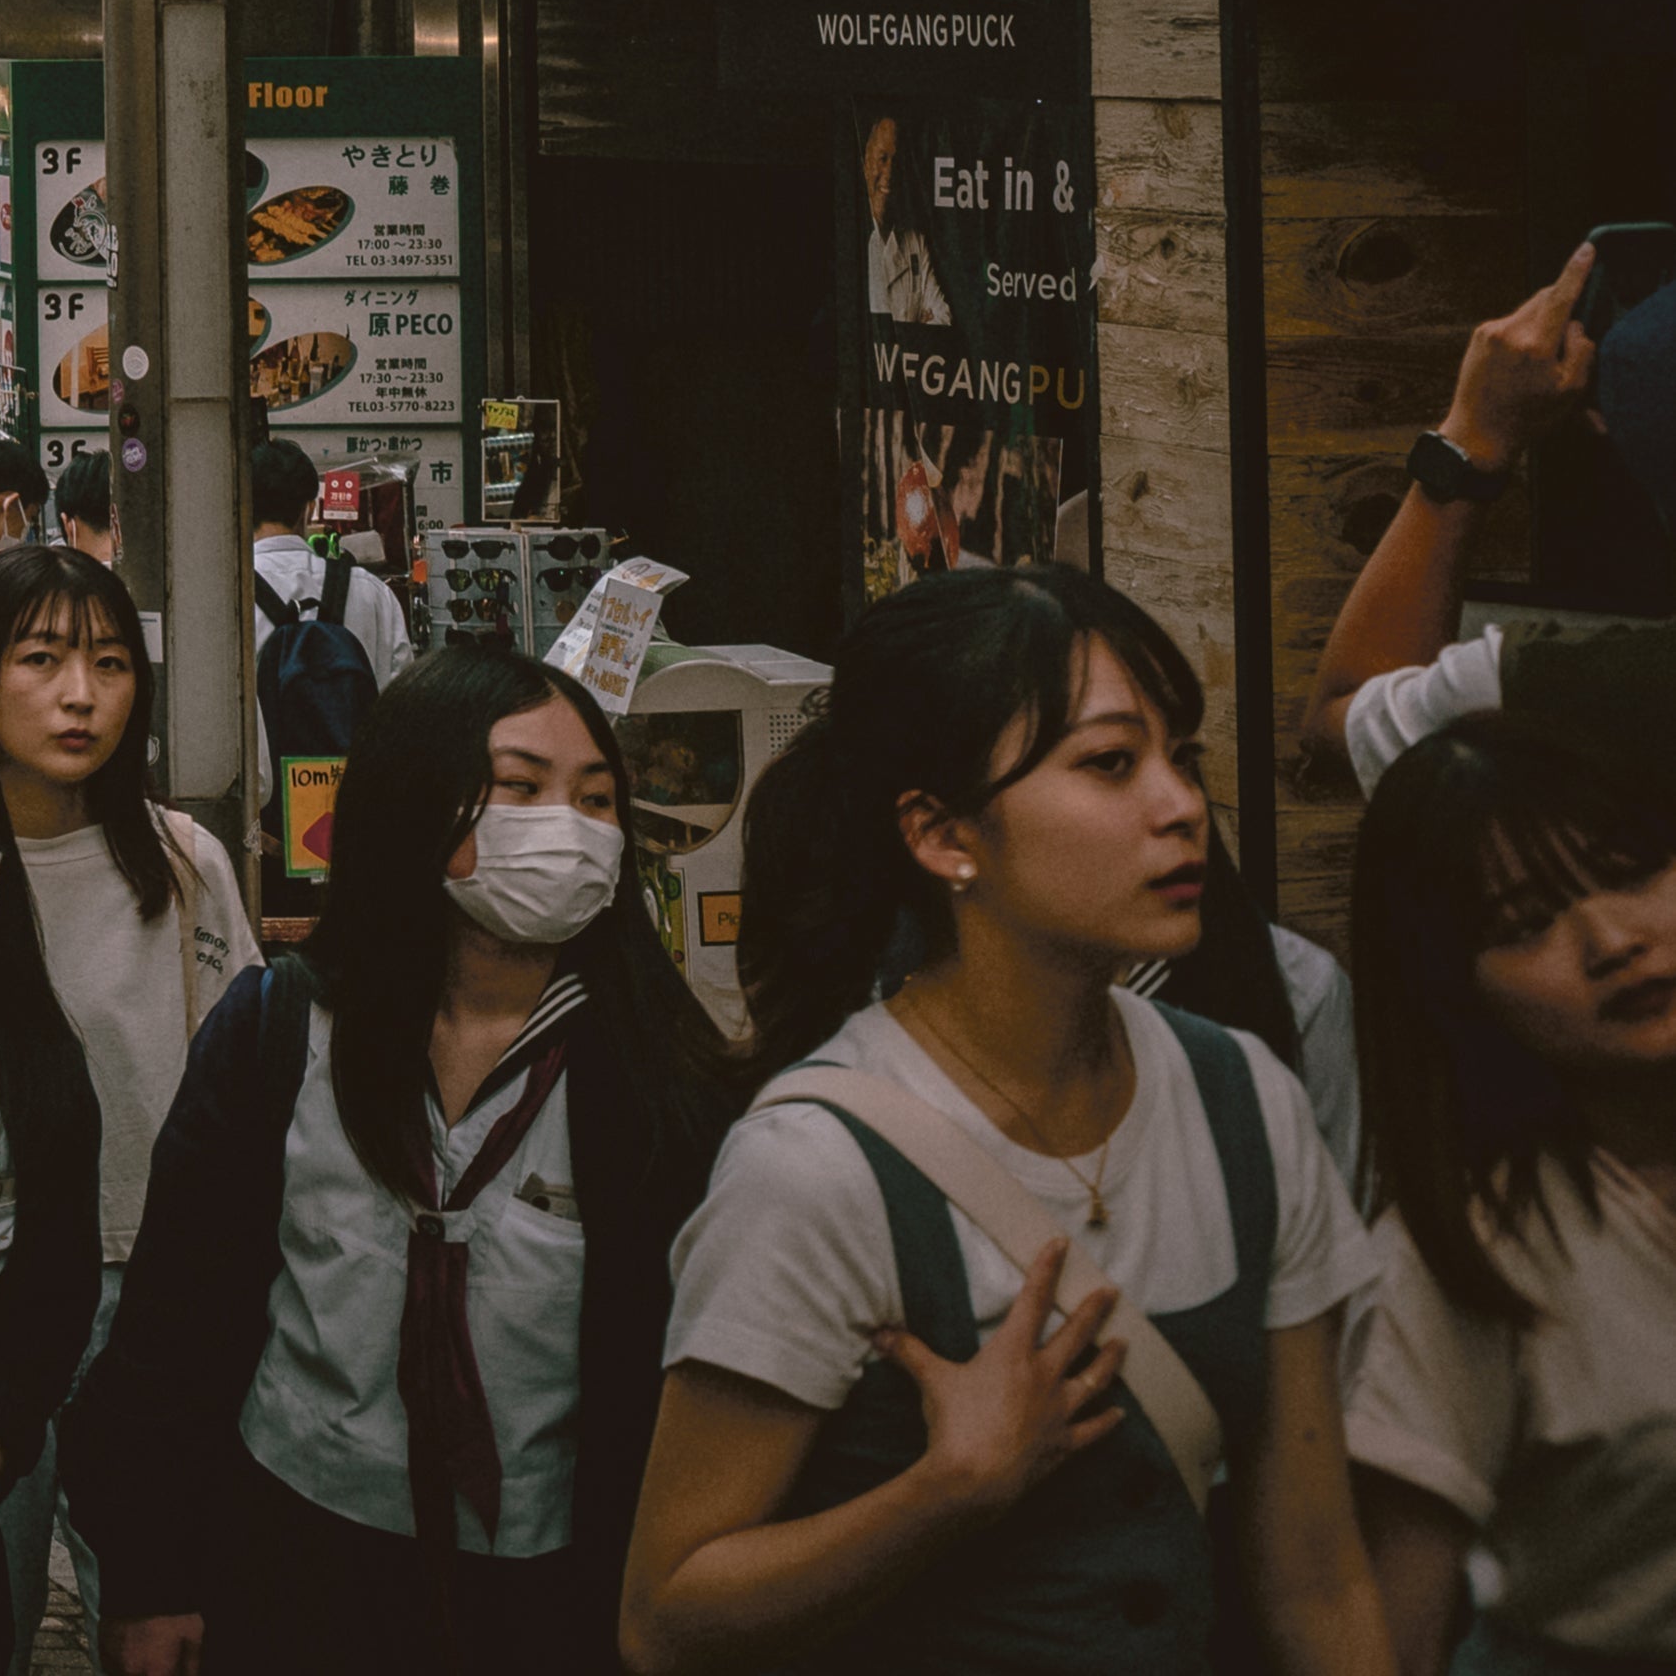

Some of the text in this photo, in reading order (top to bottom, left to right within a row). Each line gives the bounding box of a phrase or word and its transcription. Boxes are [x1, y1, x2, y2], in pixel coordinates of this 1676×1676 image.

[249, 82, 328, 108] Floor
[42, 147, 82, 175] 3F
[342, 144, 438, 168] やきとり
[934, 156, 1076, 214] Eat in &
[373, 225, 425, 236] 営業時間
[358, 239, 390, 249] 17:00
[408, 239, 442, 249] 23:30
[346, 255, 453, 266] TEL 03-3497-5351
[986, 263, 1077, 302] Served
[44, 293, 84, 320] 3F
[344, 289, 419, 307] ダイニング
[375, 358, 427, 370] 営業時間
[360, 373, 391, 383] 17:30
[409, 373, 443, 383] 23:30
[874, 343, 1085, 411] WFGANG PU
[376, 387, 427, 398] 年中無休
